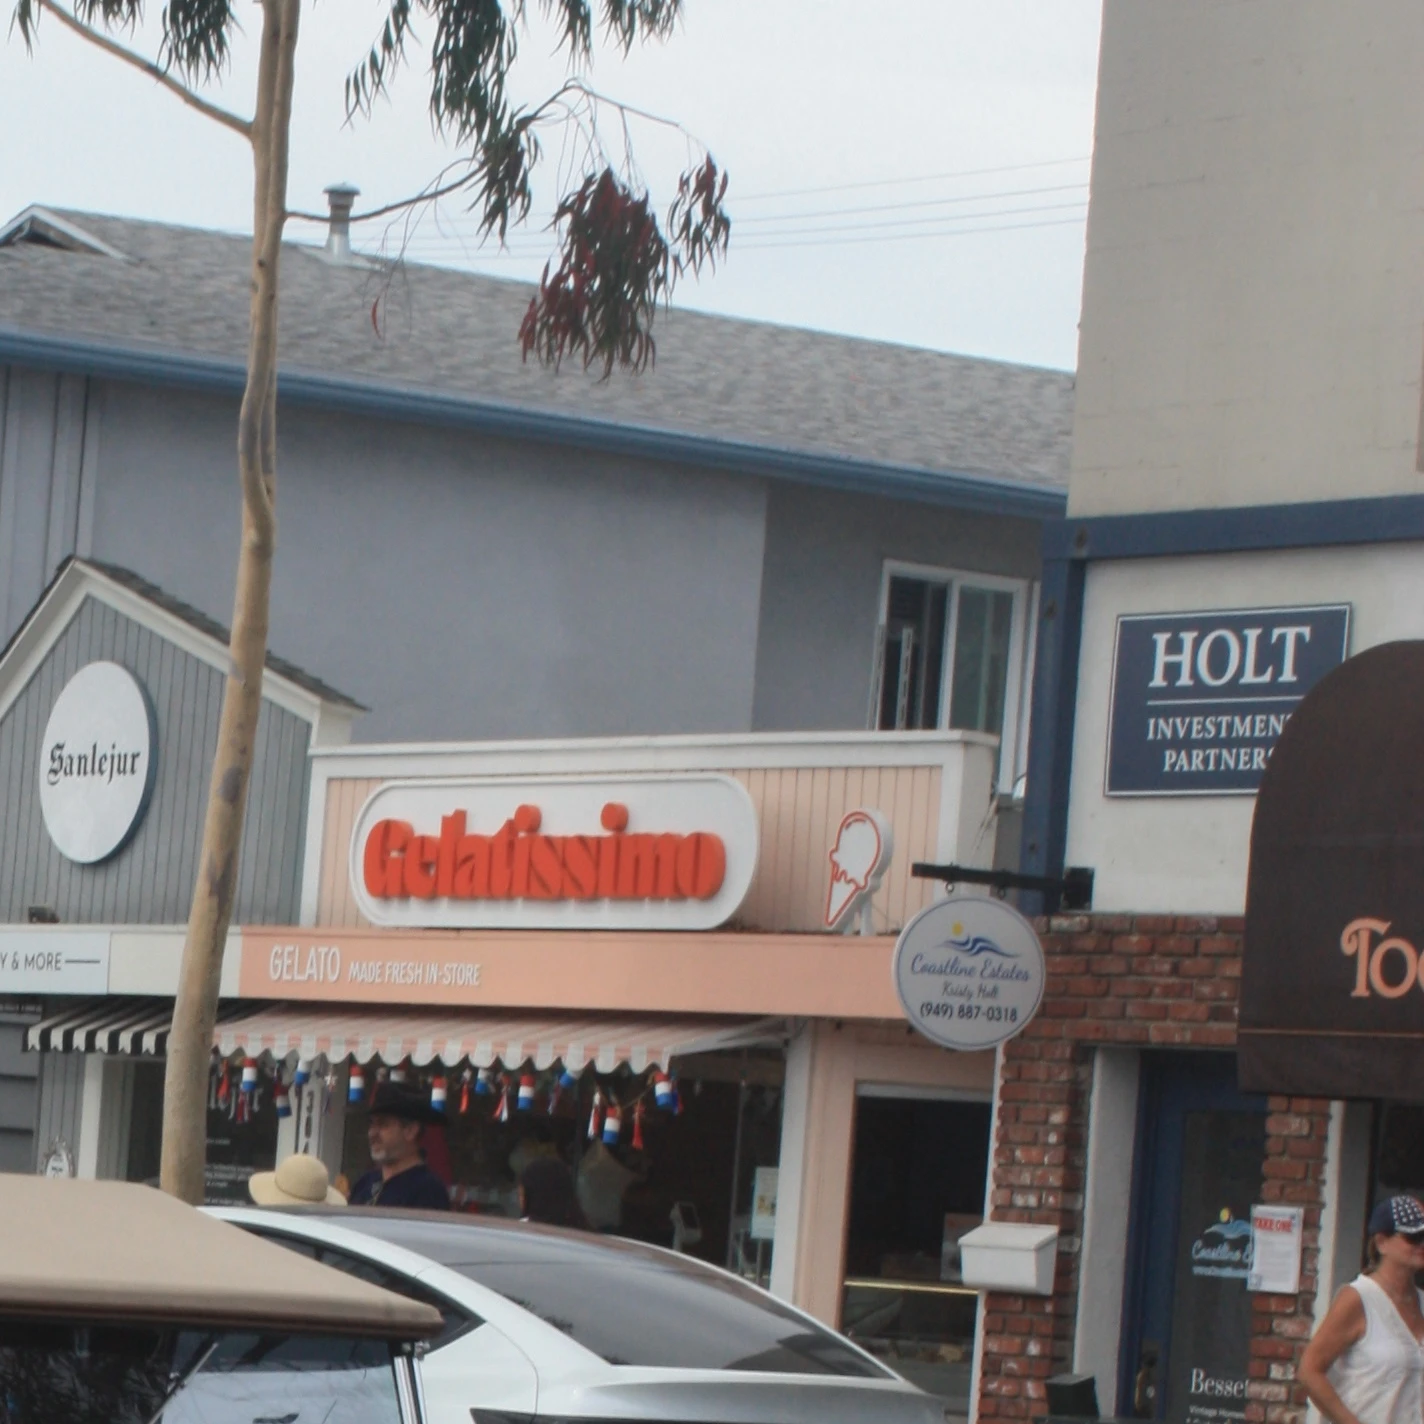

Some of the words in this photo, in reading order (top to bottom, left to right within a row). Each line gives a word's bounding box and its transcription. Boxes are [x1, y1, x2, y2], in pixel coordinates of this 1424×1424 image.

[1147, 626, 1311, 688] HOLT
[1146, 712, 1293, 741] INVESTMEN
[47, 741, 141, 786] Sanlejur
[363, 802, 727, 900] Gelatissimo
[12, 951, 19, 971] &
[24, 952, 62, 972] MORE
[269, 945, 341, 983] GELATO
[348, 961, 382, 983] MADE
[384, 961, 422, 984] FRESH
[426, 963, 482, 986] IN-STORE
[911, 954, 975, 978] Coastline
[980, 959, 1031, 982] Estates
[1340, 916, 1424, 999] To
[920, 1003, 953, 1020] (949)
[957, 1004, 1018, 1023] 887-0318
